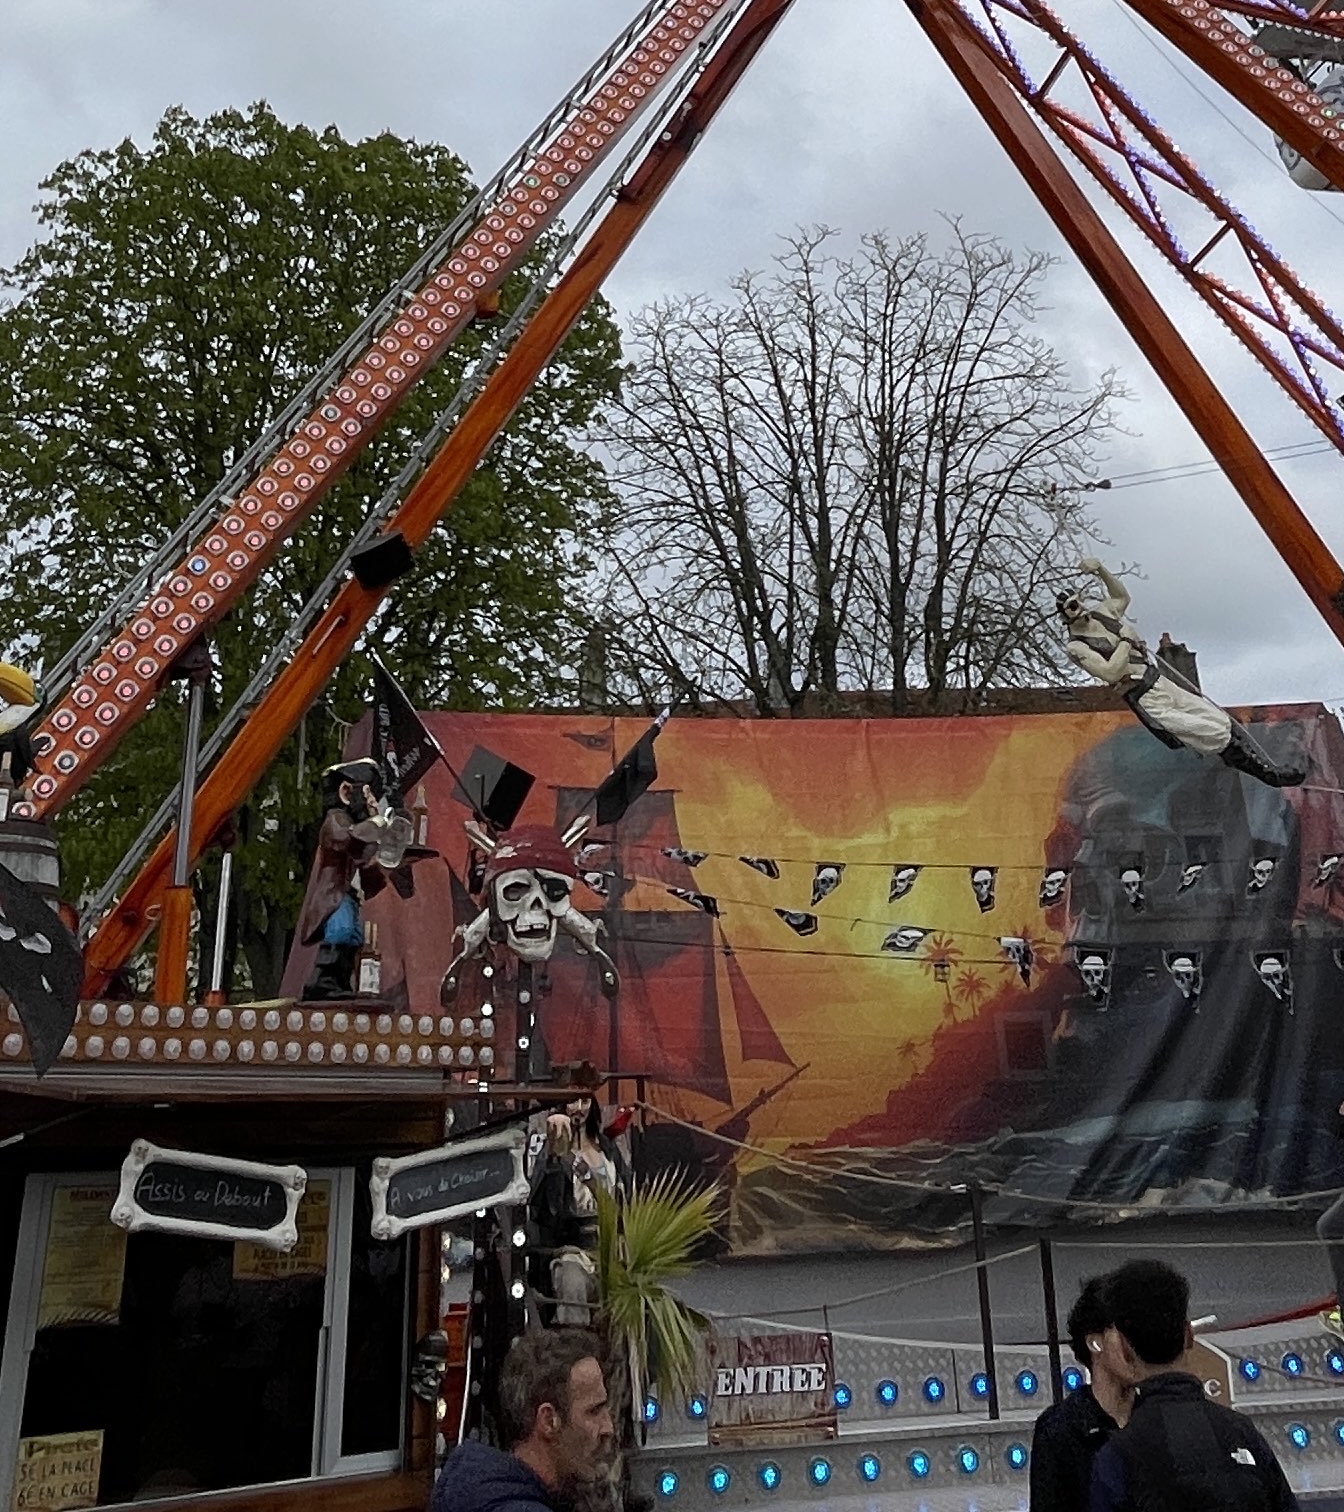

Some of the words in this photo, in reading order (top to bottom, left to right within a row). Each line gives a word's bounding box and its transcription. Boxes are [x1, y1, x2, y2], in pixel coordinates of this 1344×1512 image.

[136, 1172, 186, 1202] Assis
[214, 1180, 271, 1207] Debout
[716, 1362, 827, 1397] ENTREE
[61, 1479, 95, 1499] CAGE
